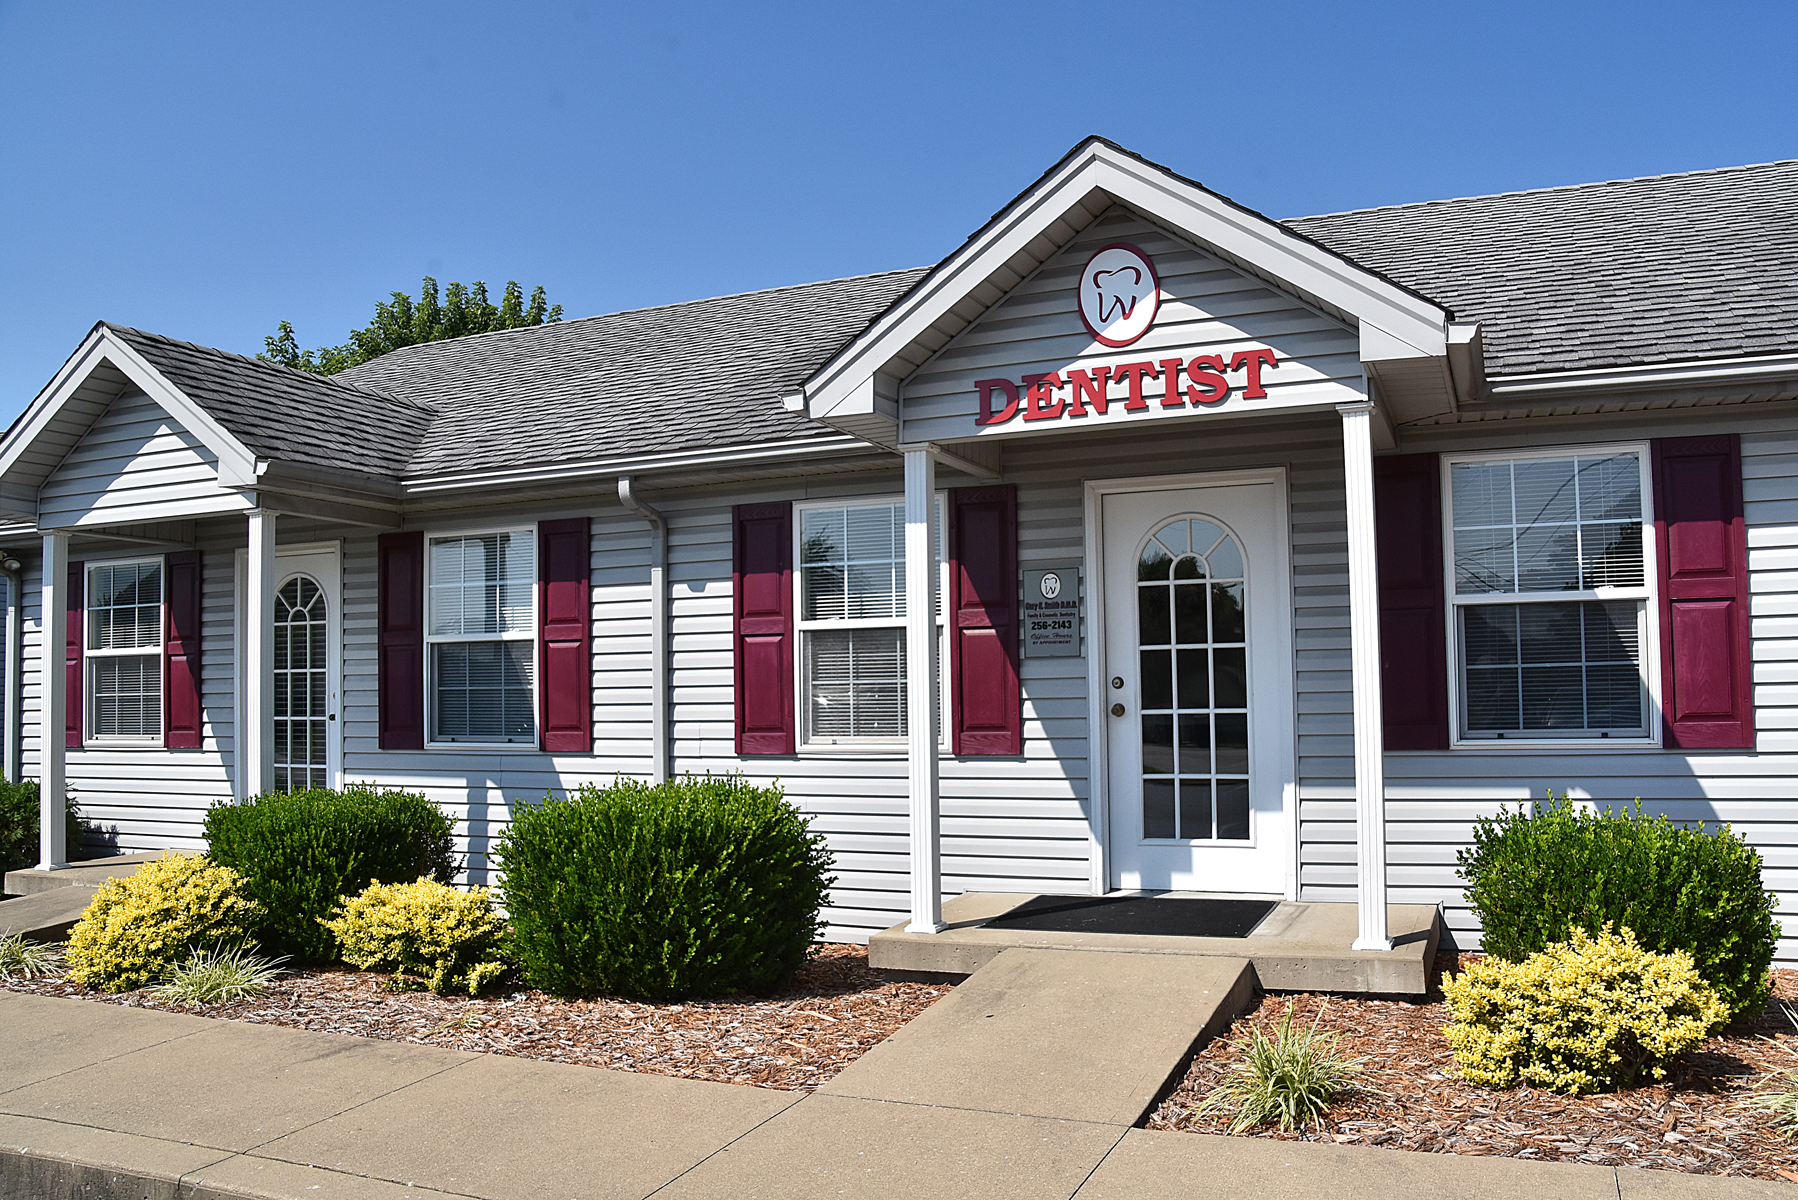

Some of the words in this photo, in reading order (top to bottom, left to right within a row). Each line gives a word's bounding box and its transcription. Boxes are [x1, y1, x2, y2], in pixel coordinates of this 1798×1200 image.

[974, 348, 1278, 426] DENTIST
[1044, 601, 1060, 609] Smith
[1031, 620, 1072, 630] 256-2143
